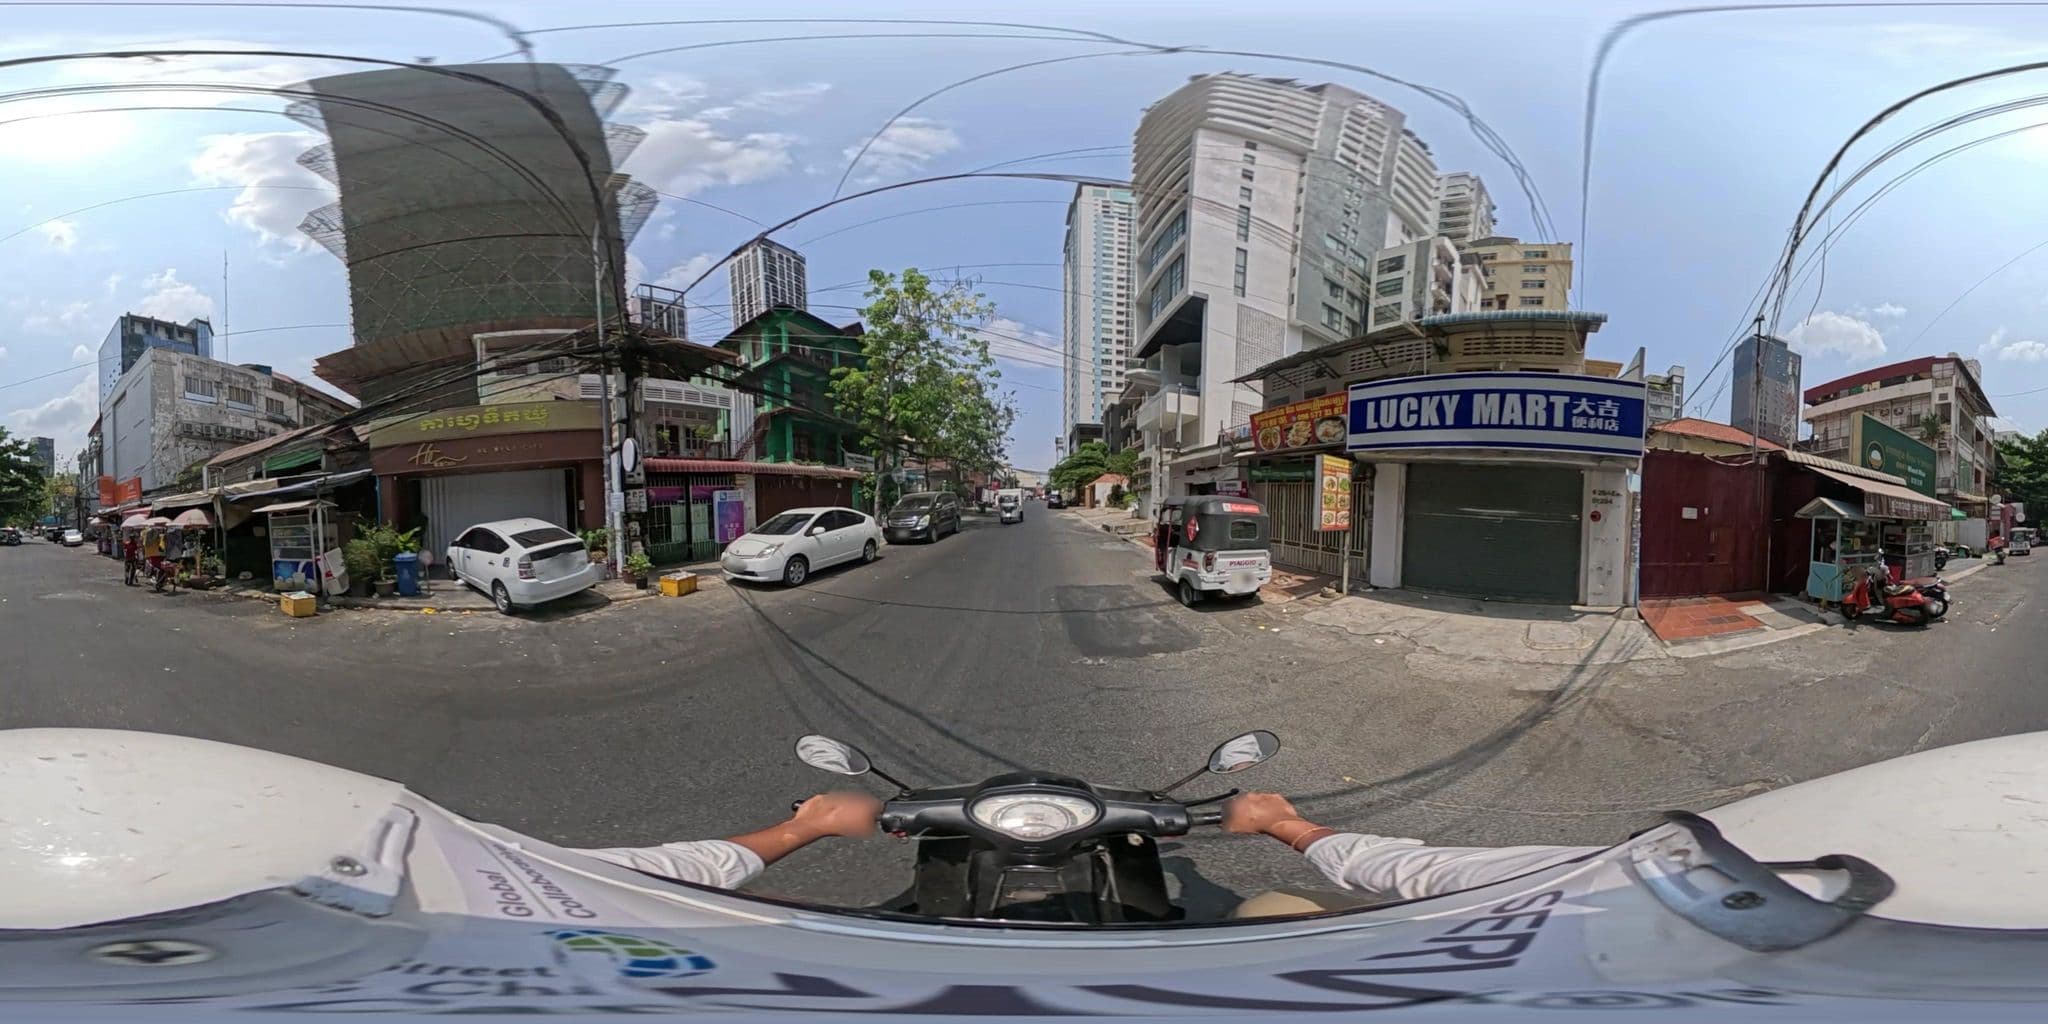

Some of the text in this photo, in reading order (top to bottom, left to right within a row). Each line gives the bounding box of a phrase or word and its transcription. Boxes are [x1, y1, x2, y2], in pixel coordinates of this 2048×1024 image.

[1366, 394, 1461, 430] LUCKY
[1471, 393, 1570, 428] MART
[1571, 397, 1621, 417] 大吉
[1571, 415, 1620, 432] 便利店
[1229, 559, 1257, 567] PIAGGIO
[476, 869, 534, 918] Global
